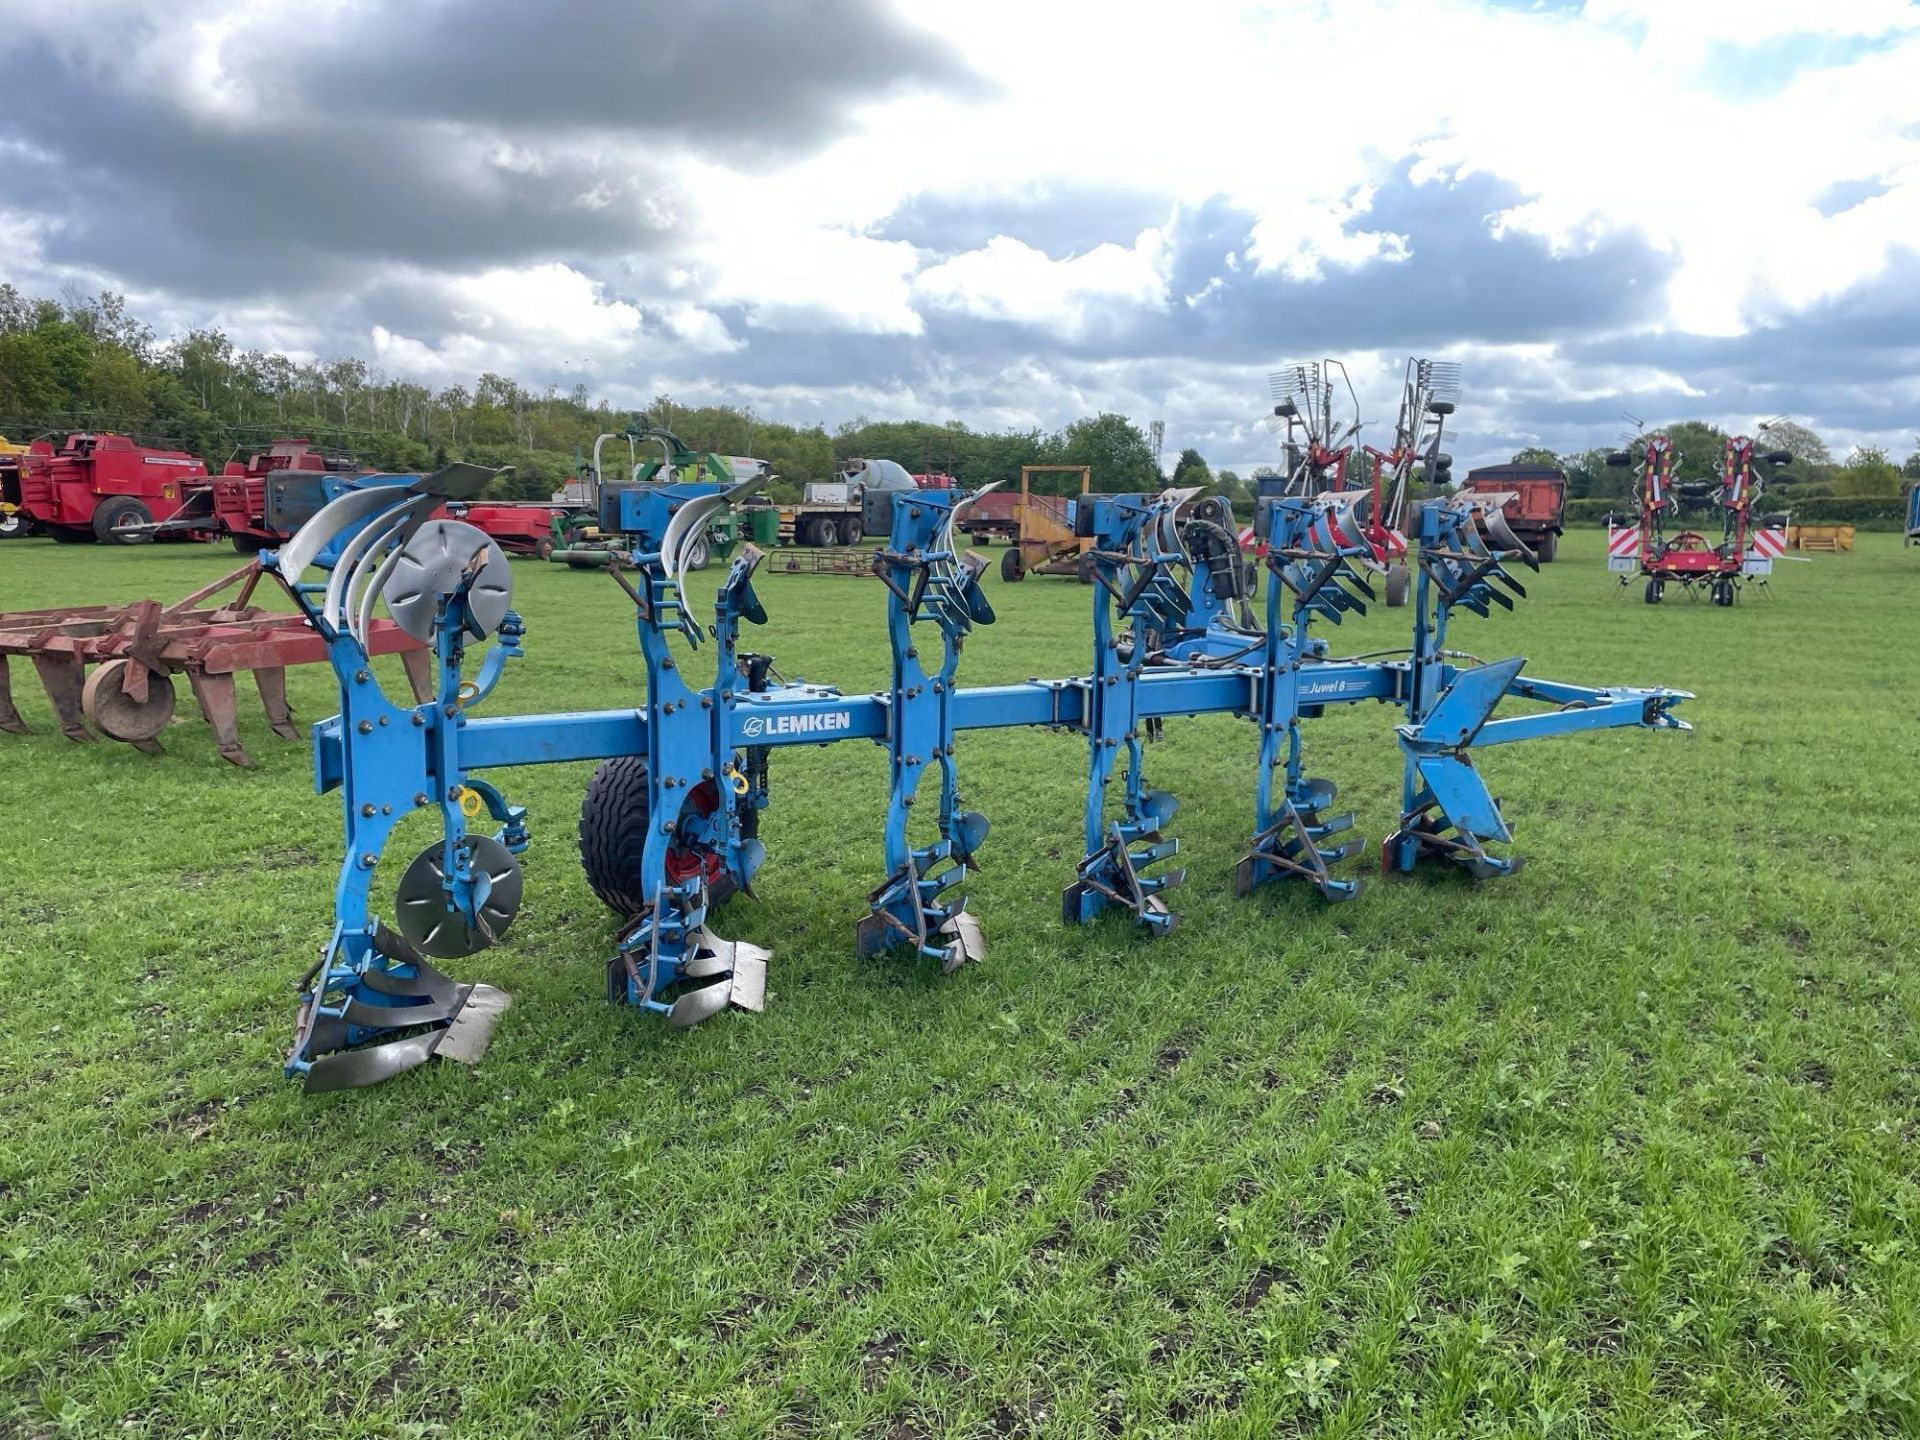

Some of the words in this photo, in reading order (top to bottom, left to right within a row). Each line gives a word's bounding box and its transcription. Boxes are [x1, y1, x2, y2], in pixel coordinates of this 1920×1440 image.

[1309, 680, 1338, 694] Juwel
[1338, 680, 1346, 691] 8
[766, 711, 850, 735] LEMKEN
